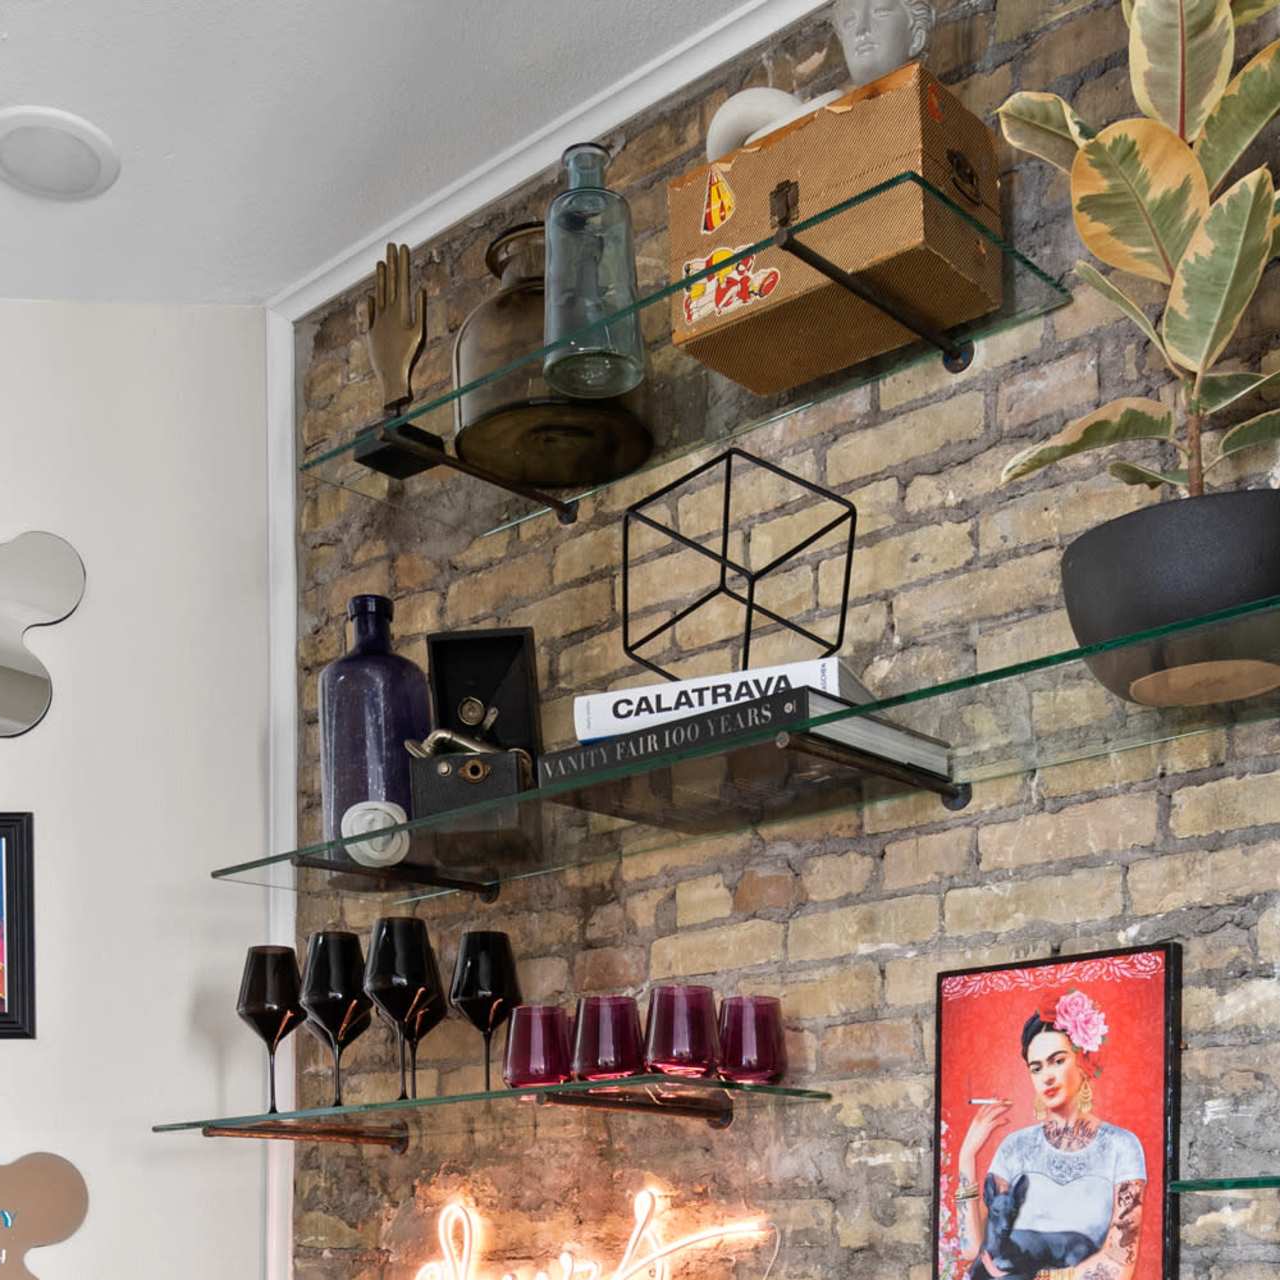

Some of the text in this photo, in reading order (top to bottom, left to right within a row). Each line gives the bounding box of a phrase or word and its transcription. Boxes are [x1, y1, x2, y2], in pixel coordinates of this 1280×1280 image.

[612, 674, 793, 719] CALATRAVA
[543, 748, 609, 780] VANITY
[615, 734, 660, 762] FAIR
[706, 704, 773, 738] YEARS
